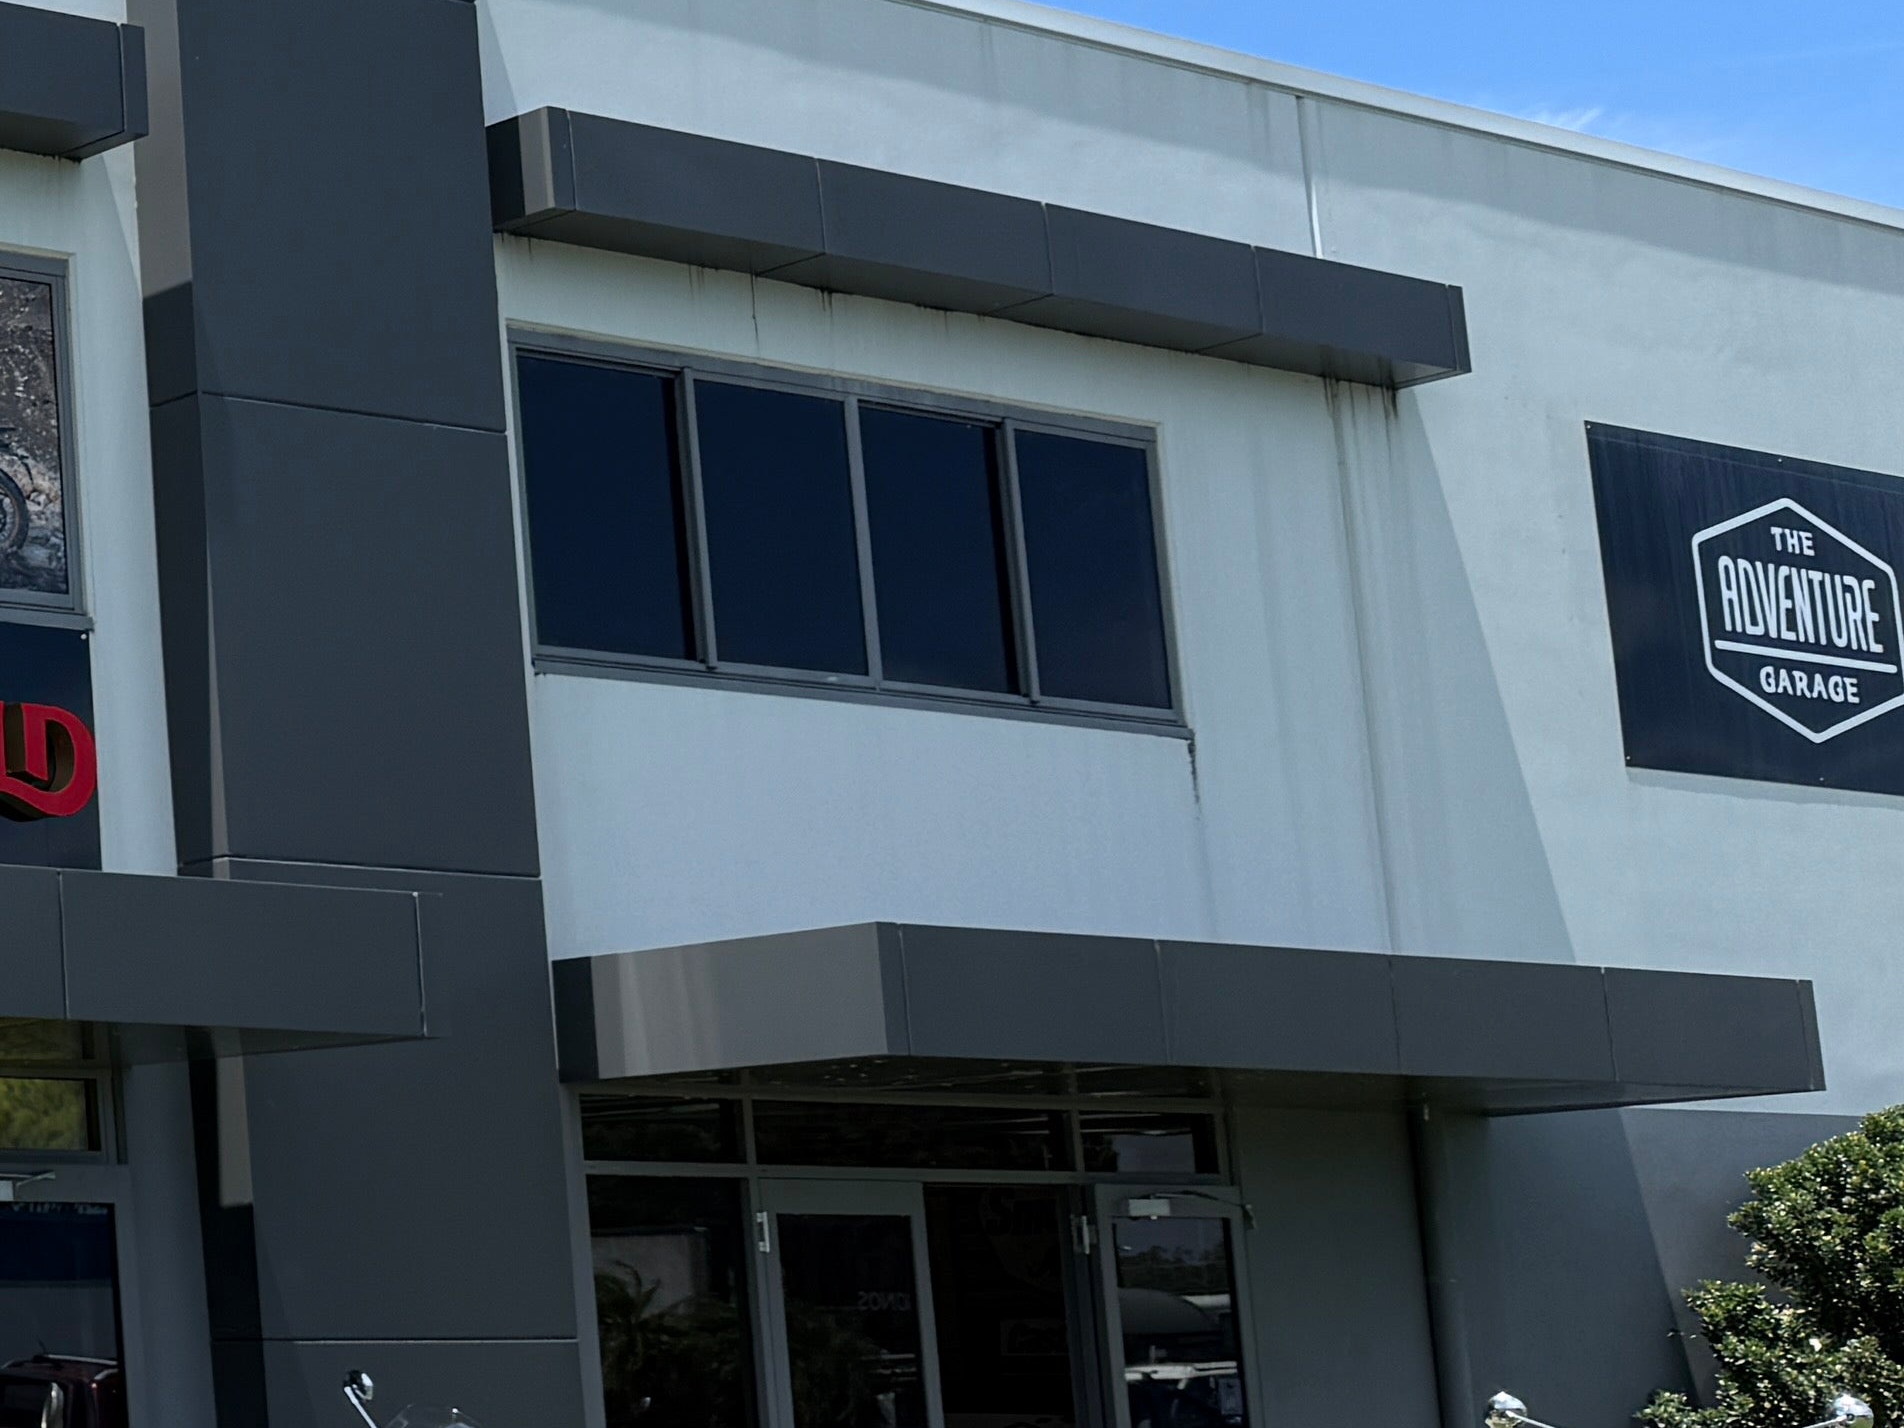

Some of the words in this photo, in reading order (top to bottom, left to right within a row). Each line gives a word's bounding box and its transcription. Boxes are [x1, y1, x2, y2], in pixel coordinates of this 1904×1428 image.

[1770, 526, 1815, 556] THE
[1718, 555, 1885, 653] ADVENTURE
[1759, 665, 1860, 704] GARAGE
